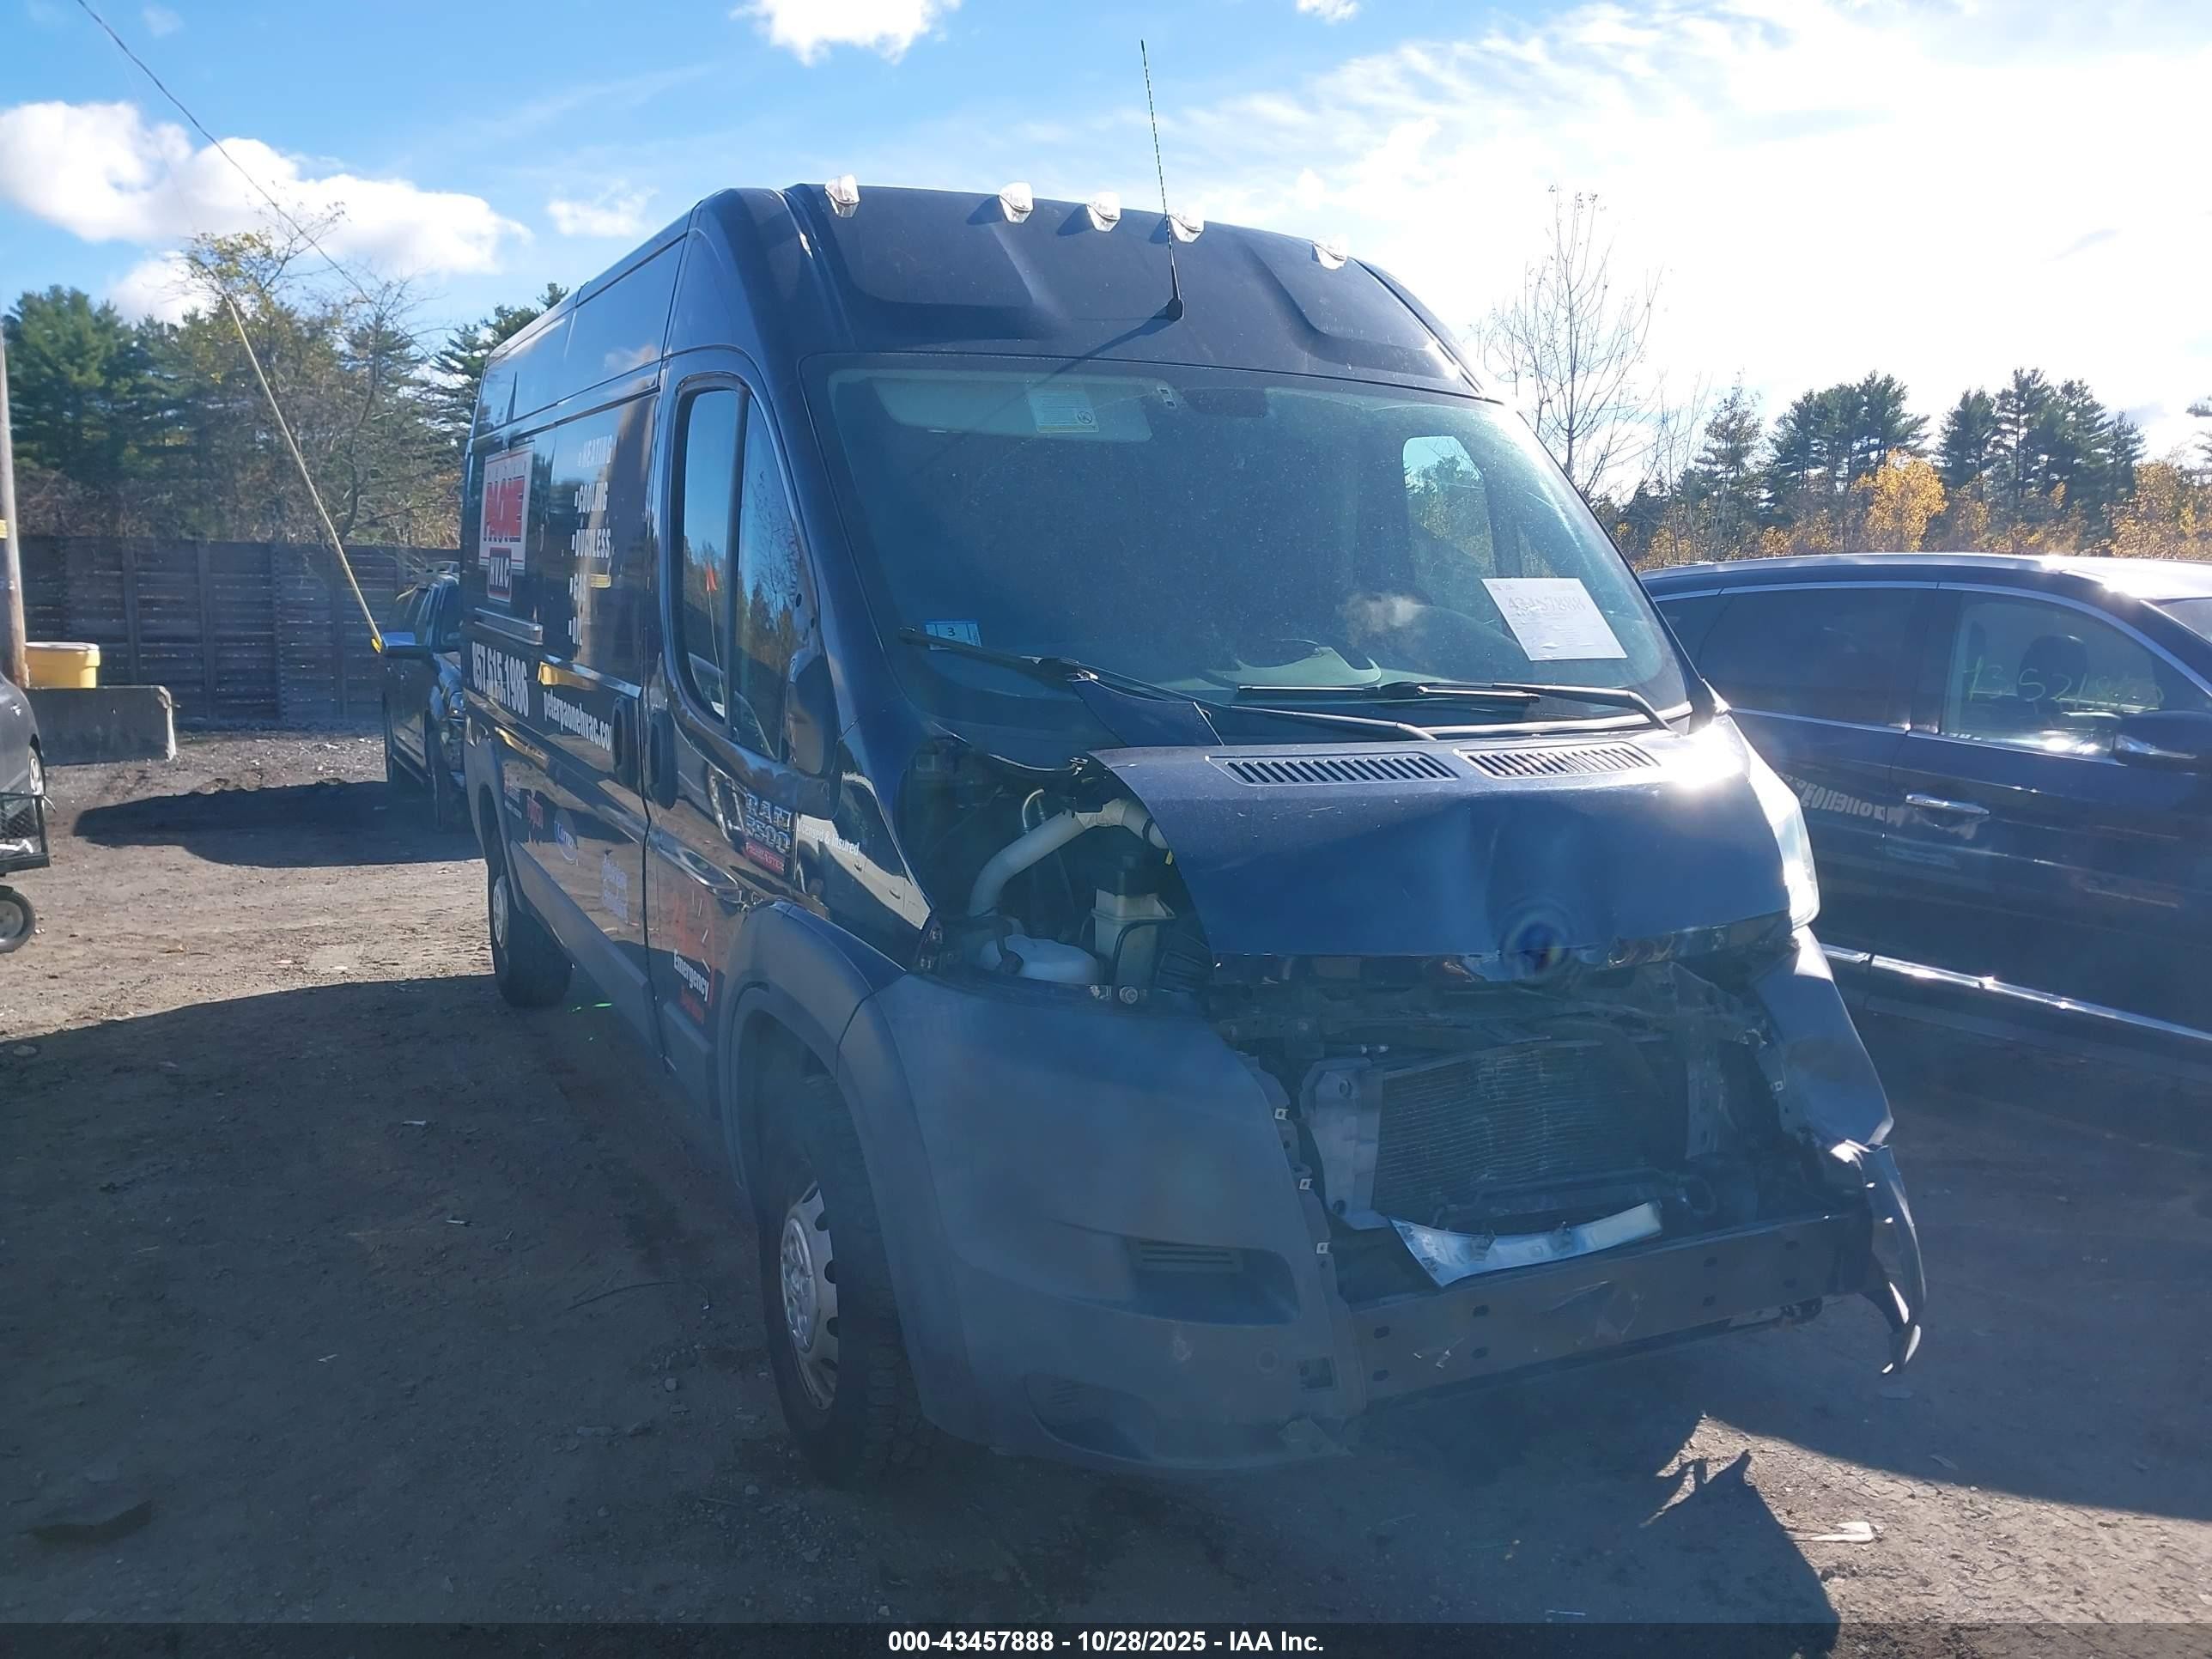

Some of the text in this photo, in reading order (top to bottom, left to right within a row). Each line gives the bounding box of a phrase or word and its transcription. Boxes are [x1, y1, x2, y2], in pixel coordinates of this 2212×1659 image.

[578, 481, 608, 513] COOLING
[575, 528, 611, 558] DUCTLESS
[489, 556, 510, 589] HVAC
[574, 573, 586, 601] GAS
[573, 617, 583, 646] OIL
[947, 627, 956, 637] 3
[473, 641, 529, 717] 857.615.1986
[745, 793, 792, 832] RAM
[797, 822, 824, 842] Licensed
[832, 833, 860, 857] Insured
[673, 948, 710, 1002] Emergency
